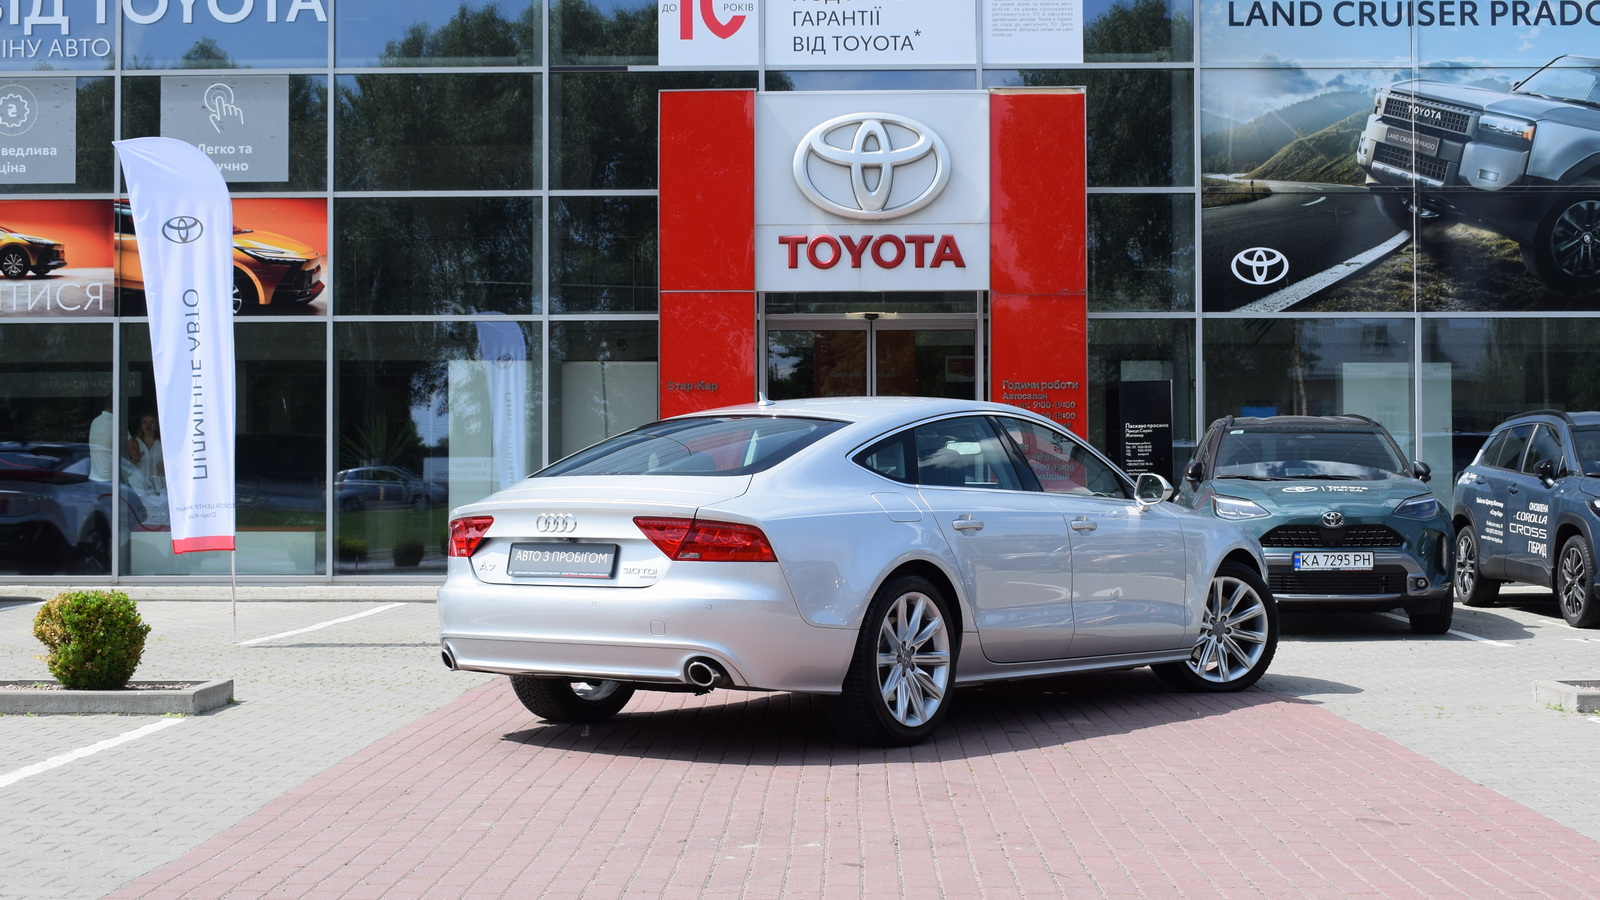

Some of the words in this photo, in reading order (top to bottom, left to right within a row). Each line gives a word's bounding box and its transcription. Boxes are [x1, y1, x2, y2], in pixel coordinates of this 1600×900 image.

[662, 4, 677, 13] ДО
[723, 3, 754, 12] РОКІВ
[1228, 0, 1322, 27] LAND
[1333, 0, 1479, 27] CRUISER
[0, 0, 69, 35] ІД
[792, 6, 882, 26] ГАРАНТІЇ
[48, 38, 111, 57] АВТО
[793, 36, 826, 55] ВІД
[1408, 105, 1441, 120] TOYOTA
[198, 143, 236, 154] Легко
[238, 145, 253, 154] та
[778, 234, 966, 269] TOYOTA
[0, 282, 103, 311] ТИСЯ
[667, 380, 718, 392] Стар-Кар
[1002, 380, 1039, 390] Години
[1041, 380, 1079, 391] роботи
[1002, 392, 1048, 400] Автосалон
[1516, 511, 1548, 525] COROLLA
[1509, 522, 1547, 539] CROSS
[515, 550, 541, 562] АВТО
[552, 551, 608, 565] ПРОБІГОМ
[1302, 554, 1319, 566] KA
[1322, 554, 1350, 566] 7295
[1354, 554, 1371, 566] PH
[479, 561, 497, 572] A7
